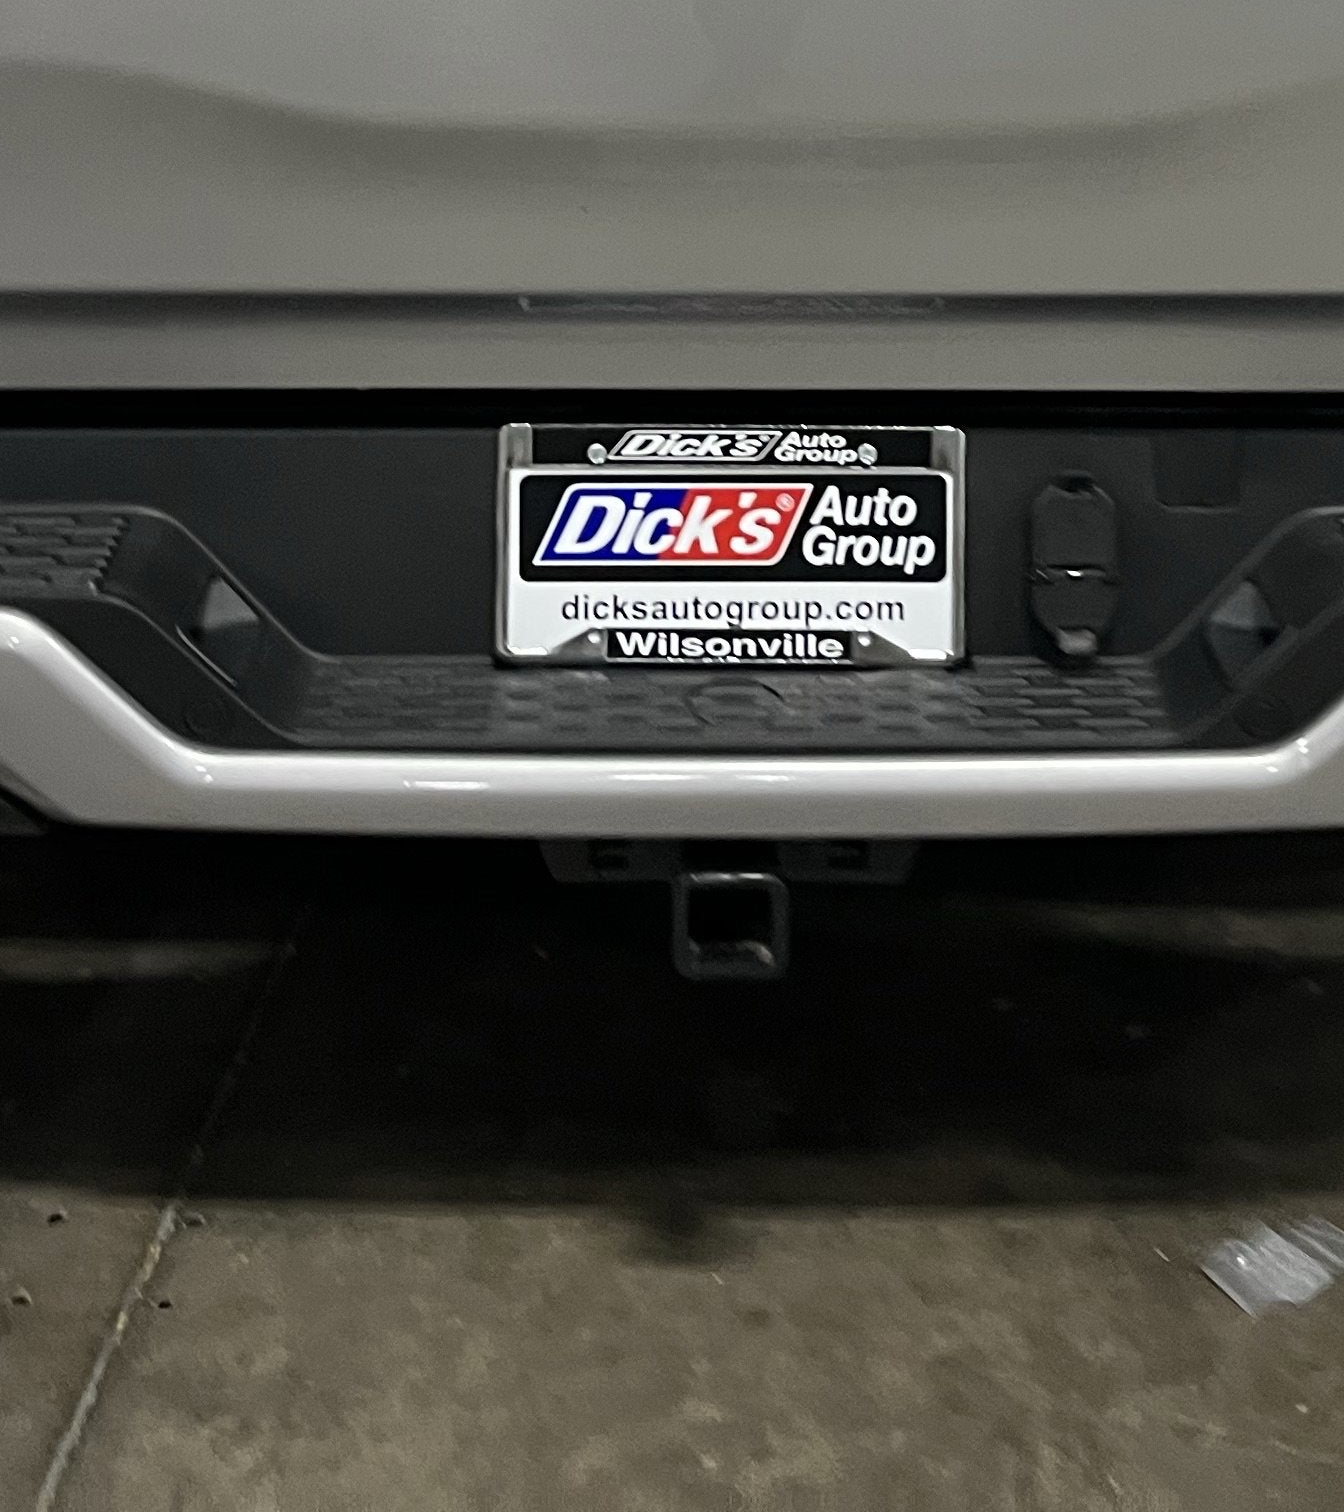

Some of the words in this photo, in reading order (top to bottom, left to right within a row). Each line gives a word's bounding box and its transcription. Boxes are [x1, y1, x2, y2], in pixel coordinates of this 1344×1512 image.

[774, 446, 858, 466] Group
[781, 431, 847, 449] Auto
[809, 485, 918, 527] Auto
[801, 526, 937, 575] Group
[561, 593, 906, 629] dicksautogroup.com
[614, 630, 845, 660] Wilsonville
